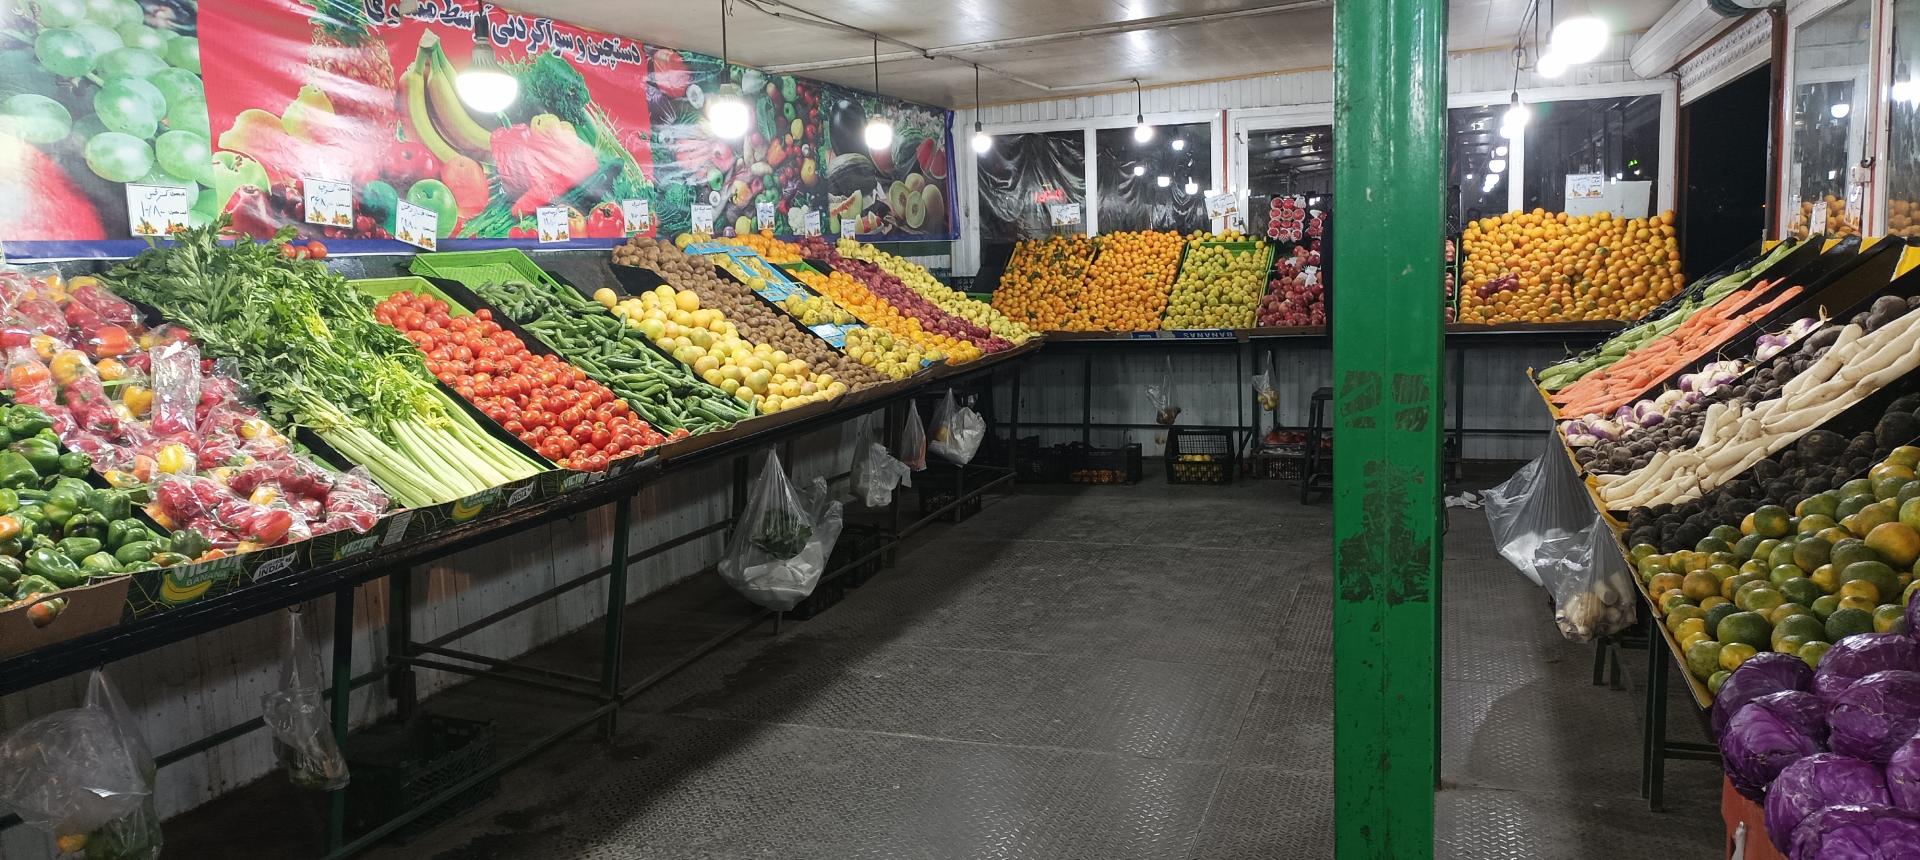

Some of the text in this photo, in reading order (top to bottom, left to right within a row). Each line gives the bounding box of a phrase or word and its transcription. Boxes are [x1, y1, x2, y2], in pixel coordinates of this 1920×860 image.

[575, 35, 586, 62] و
[588, 36, 640, 69] دستچین
[259, 562, 284, 577] INDIA
